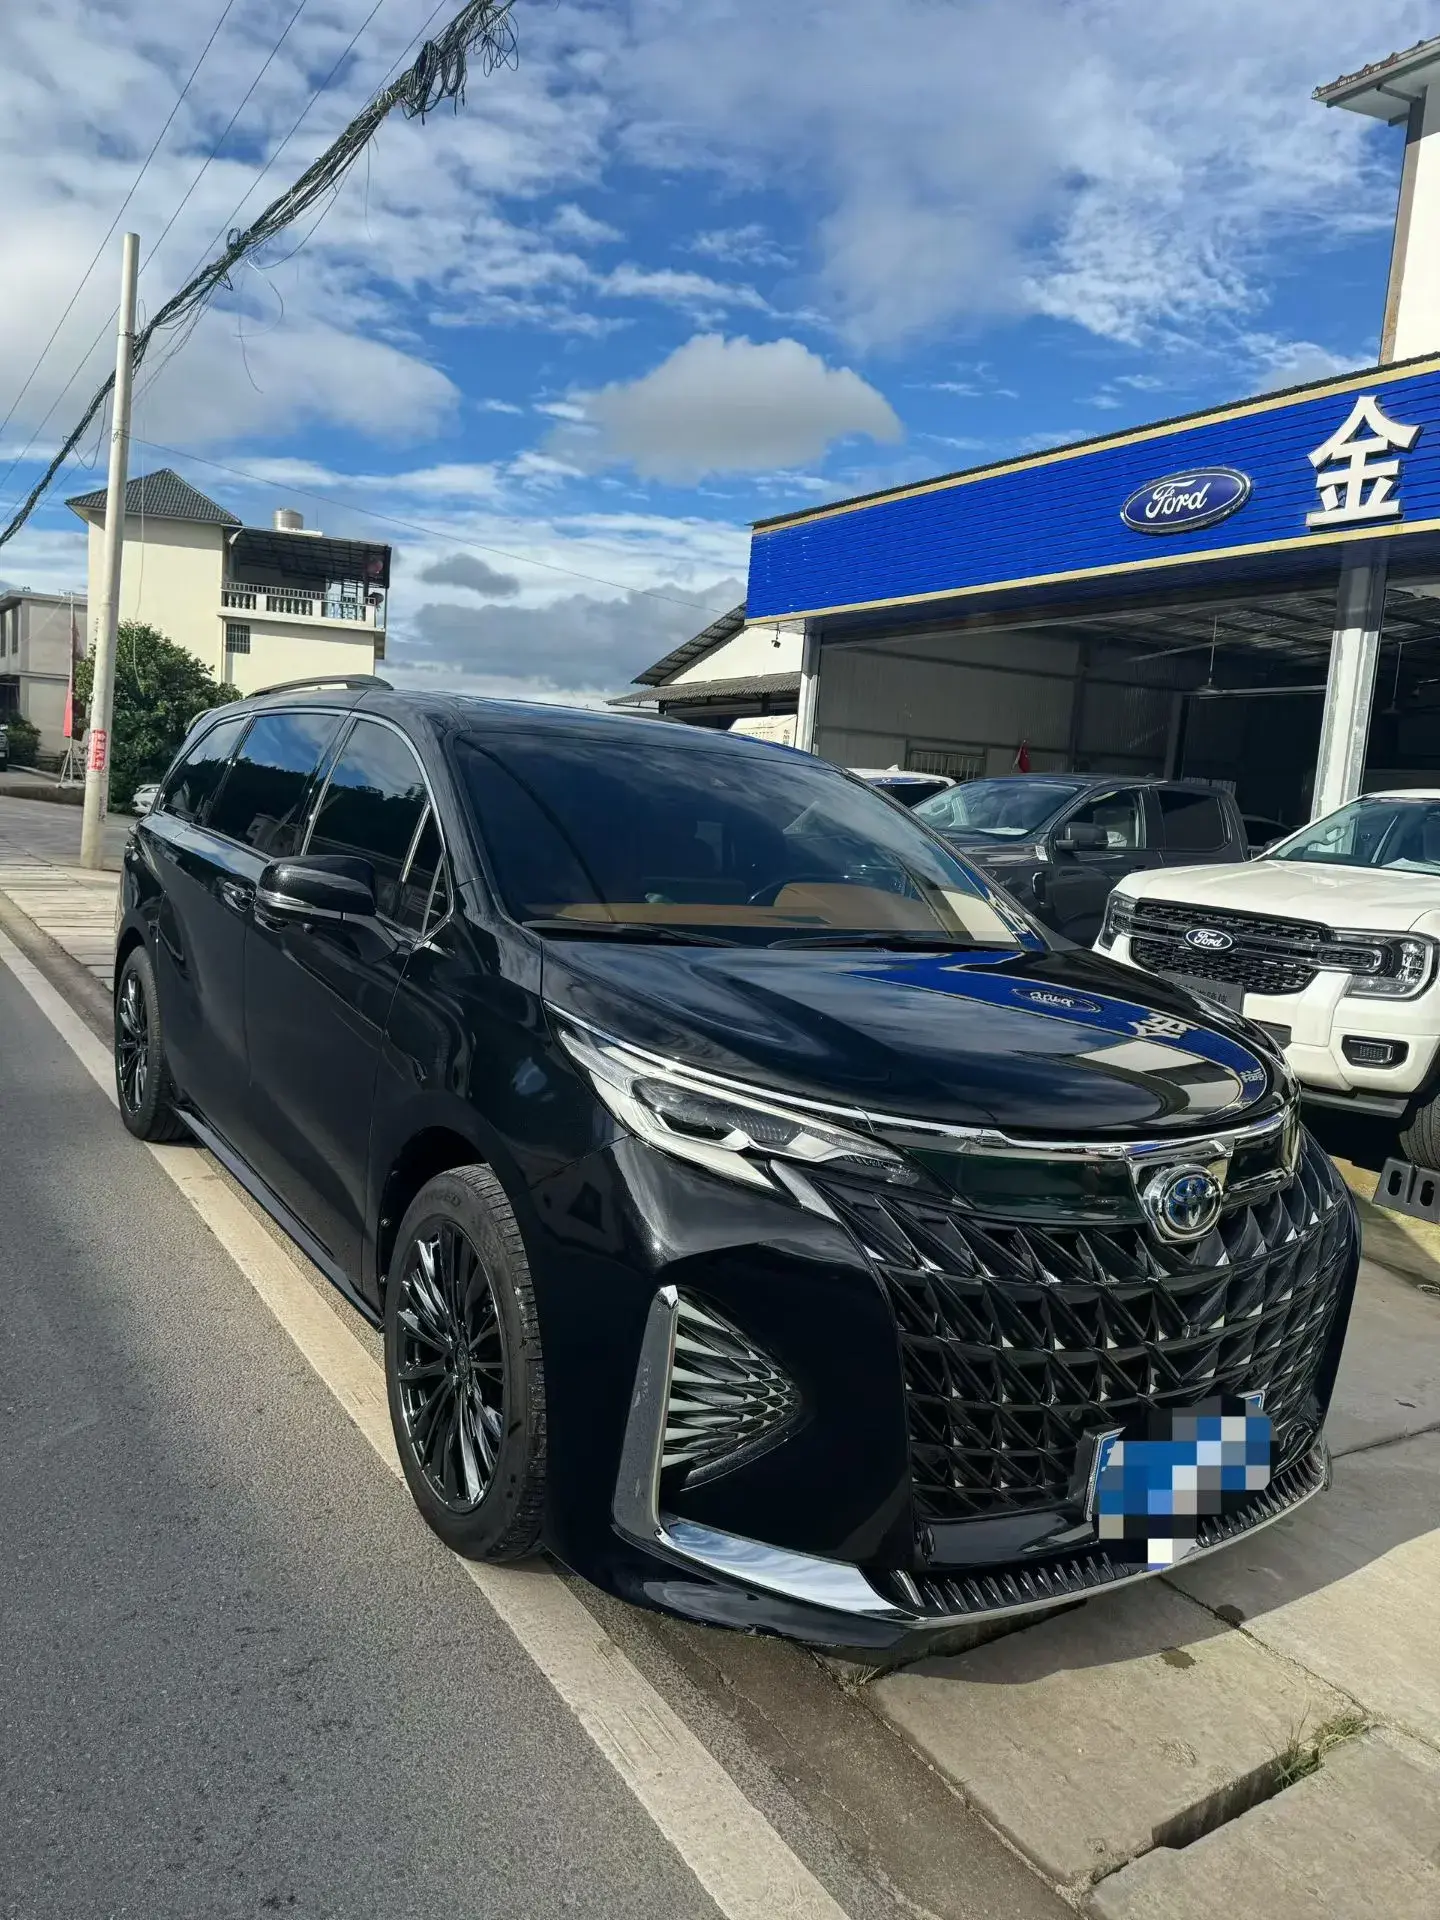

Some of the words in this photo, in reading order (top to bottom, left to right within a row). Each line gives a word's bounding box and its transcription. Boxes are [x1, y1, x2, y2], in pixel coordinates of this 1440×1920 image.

[1305, 395, 1422, 528] 金
[1145, 479, 1211, 519] Ford
[1193, 930, 1224, 947] Ford
